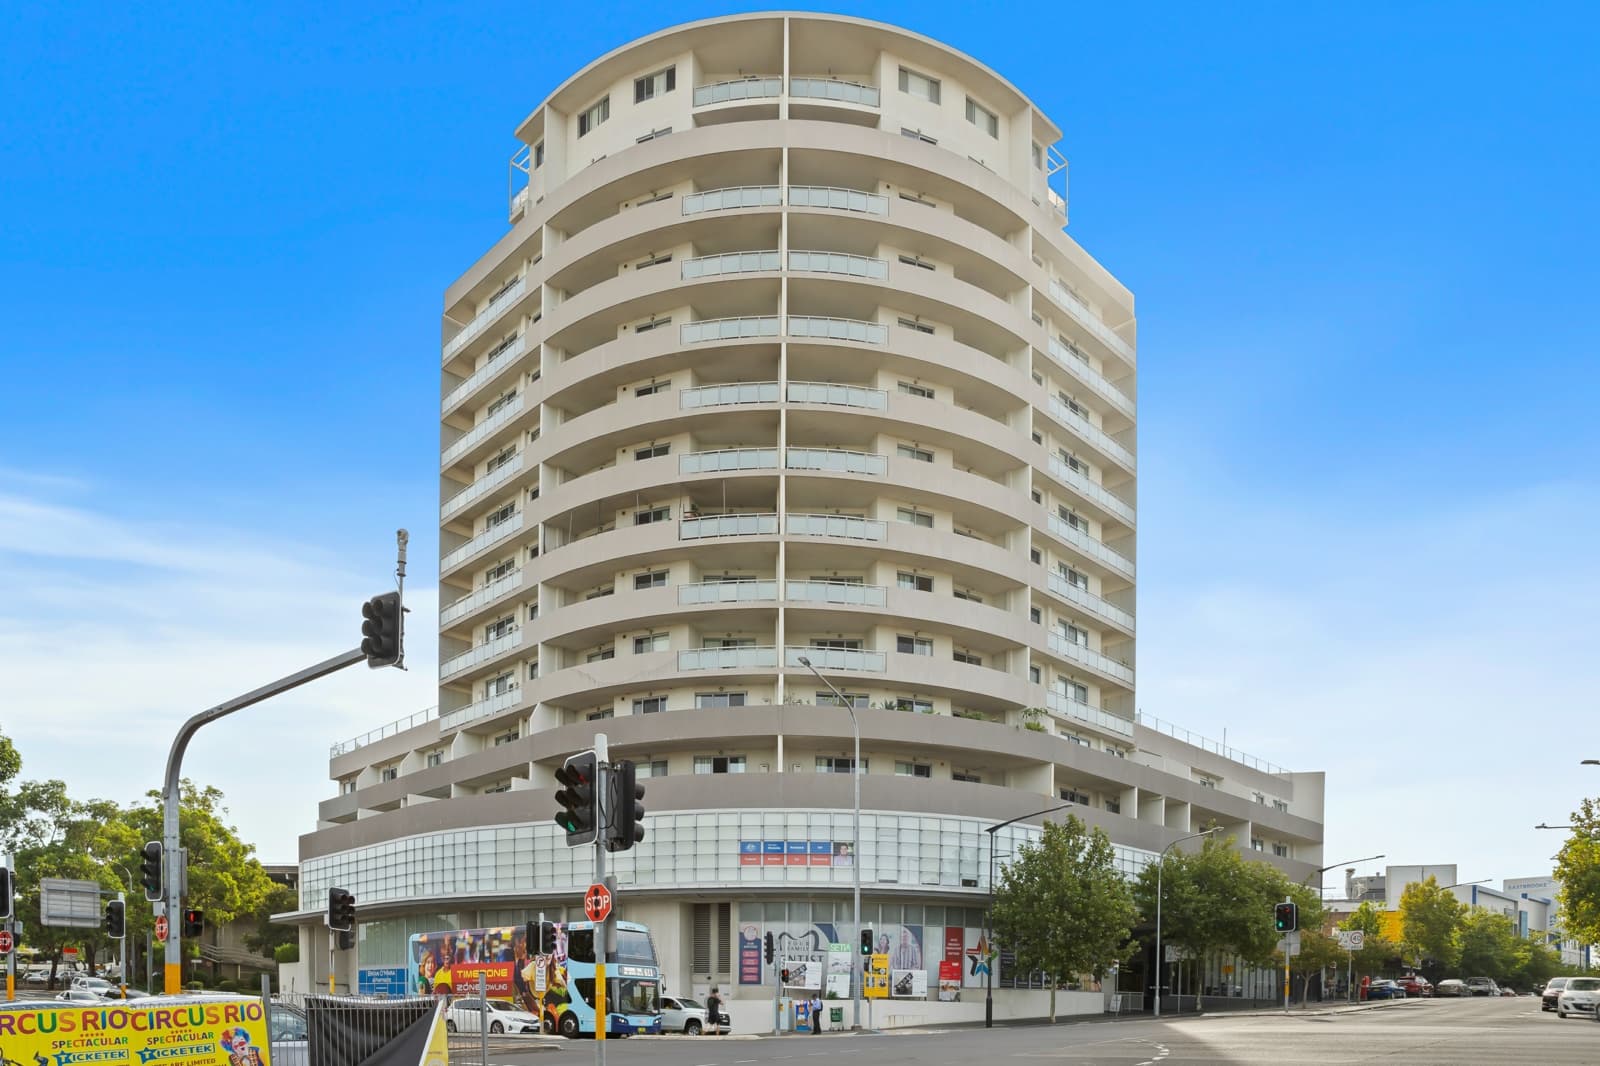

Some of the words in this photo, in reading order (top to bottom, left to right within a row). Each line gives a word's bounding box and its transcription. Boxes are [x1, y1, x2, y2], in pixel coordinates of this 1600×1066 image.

[586, 895, 610, 911] STOP
[456, 968, 508, 979] TIMEONE
[485, 983, 508, 991] OWLING
[82, 1009, 128, 1031] RIO
[130, 1006, 220, 1031] CIRCUS
[224, 1003, 262, 1023] RIO
[52, 1037, 128, 1049] SPECTACULAR
[147, 1031, 214, 1045] SPECTACULAR
[59, 1050, 126, 1064] TICKETEK
[143, 1045, 212, 1061] TICKETEK
